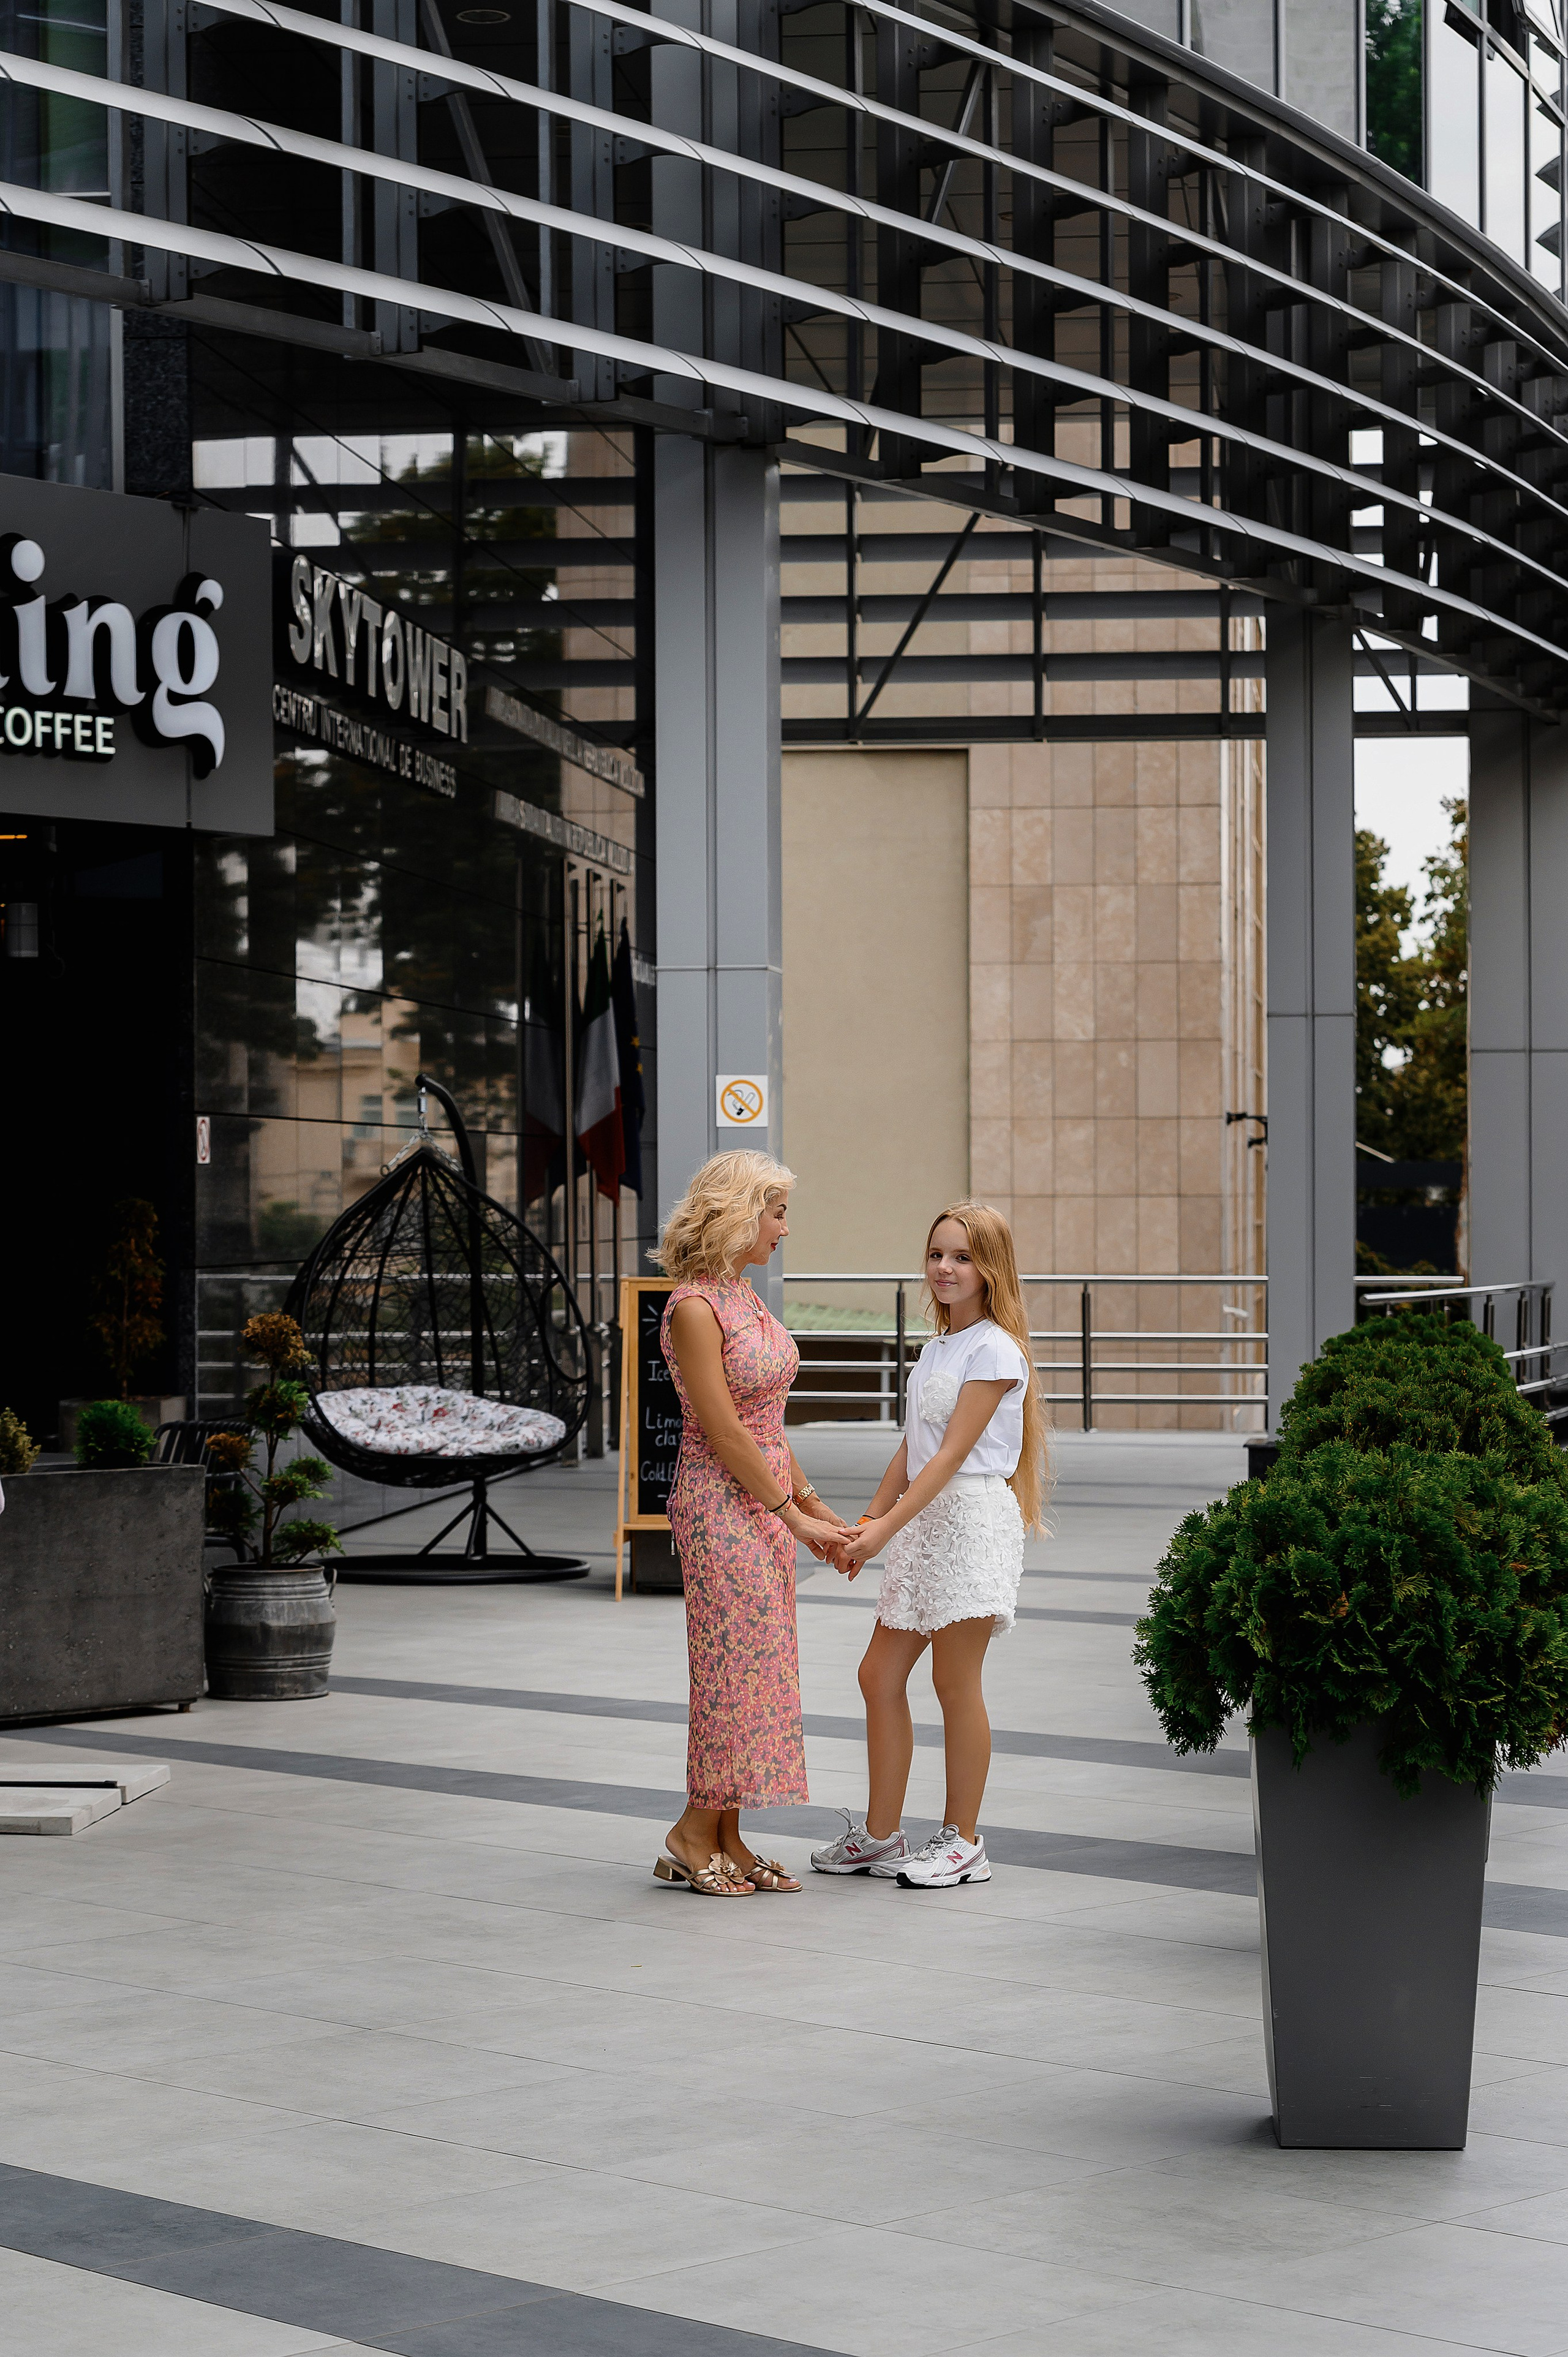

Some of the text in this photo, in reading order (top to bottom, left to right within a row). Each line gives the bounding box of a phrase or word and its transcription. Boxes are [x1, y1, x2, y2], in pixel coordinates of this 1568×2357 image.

[0, 539, 225, 769] ing
[288, 554, 469, 744] SKYTOWER
[0, 706, 116, 755] OFFEE
[273, 684, 317, 736] CENTRU
[320, 704, 398, 772] INTERNATIONAL
[399, 742, 413, 779] DE
[640, 1460, 666, 1482] Cold
[845, 1842, 863, 1858] N
[946, 1850, 964, 1865] N
